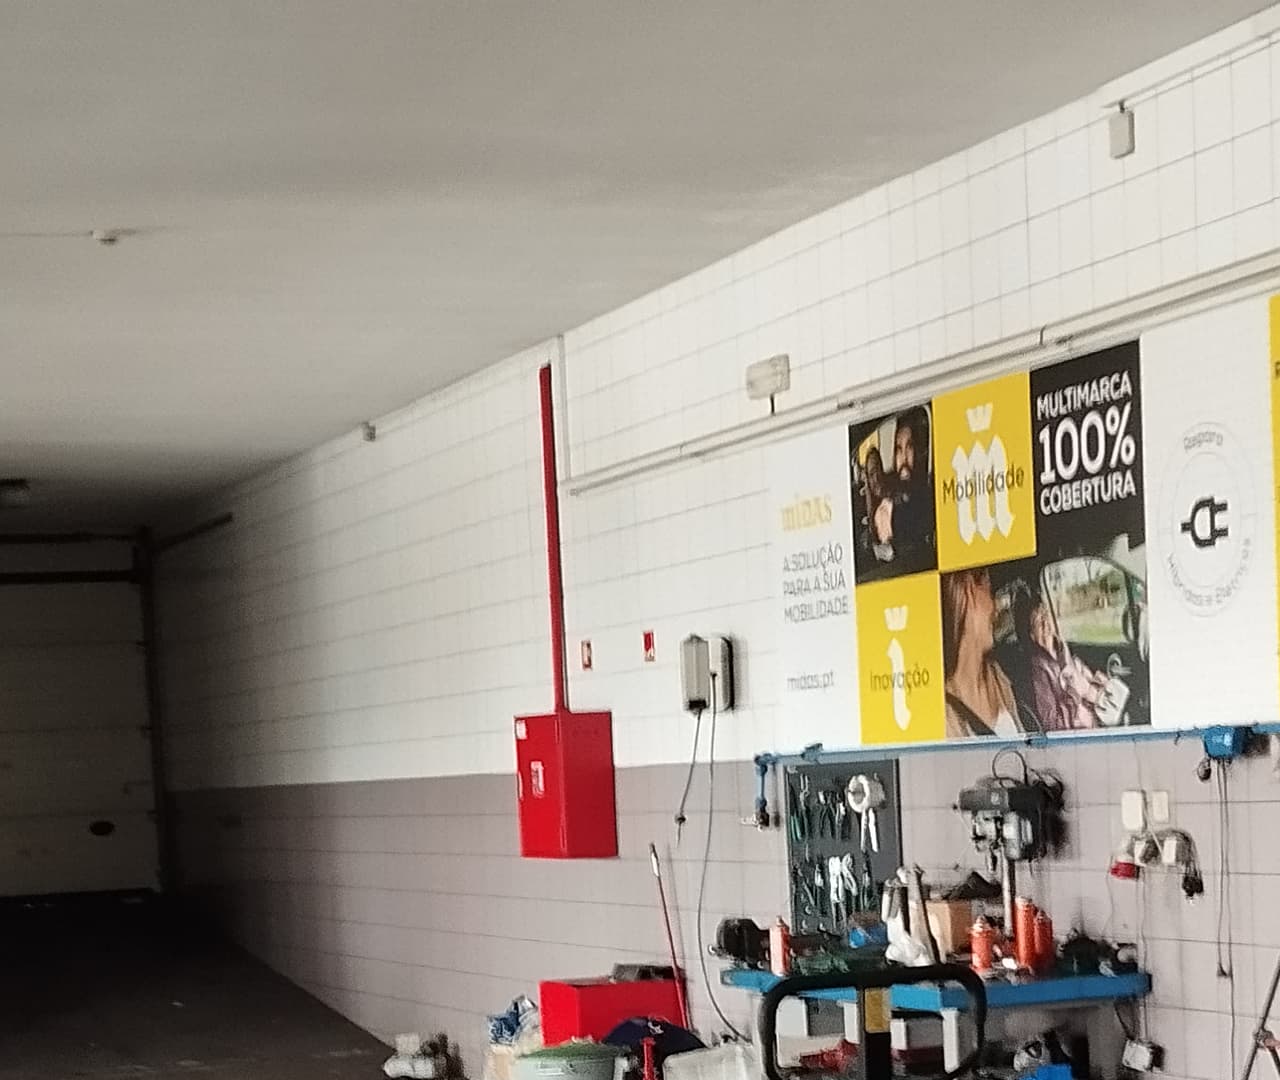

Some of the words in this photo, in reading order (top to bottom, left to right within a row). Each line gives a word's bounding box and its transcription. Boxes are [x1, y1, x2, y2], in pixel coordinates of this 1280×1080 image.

[1037, 371, 1132, 421] MULTIMARCA
[1039, 402, 1136, 484] 100%
[943, 464, 1024, 503] Mobilidade
[1040, 469, 1136, 516] COBERTURA
[783, 556, 791, 572] A
[792, 541, 843, 571] SOLUÇÃO
[783, 577, 812, 597] PARA
[814, 575, 822, 592] A
[823, 568, 846, 591] SUA
[784, 595, 848, 623] MOBILIDADE
[786, 670, 834, 692] midas.pt
[870, 663, 930, 695] Inovação
